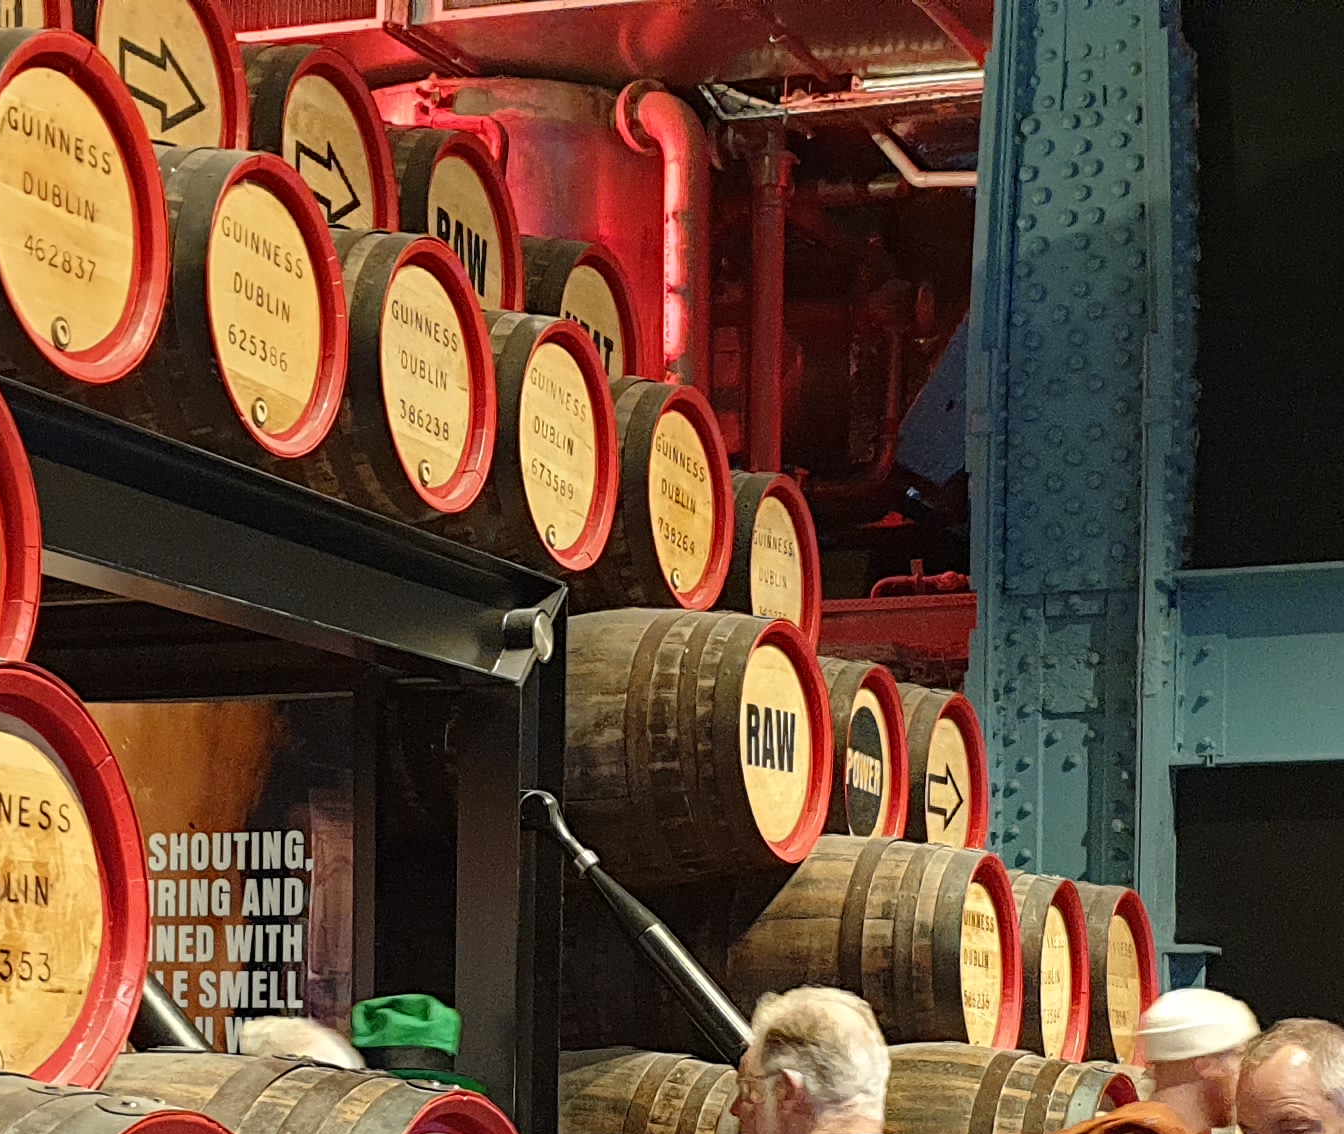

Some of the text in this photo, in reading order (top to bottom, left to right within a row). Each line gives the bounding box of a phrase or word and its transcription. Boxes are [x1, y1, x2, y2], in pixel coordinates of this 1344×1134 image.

[7, 105, 113, 175] GUINNESS
[22, 171, 96, 223] DUBLIN
[24, 234, 96, 282] 462837
[222, 215, 304, 279] GUINNESS
[233, 271, 290, 323] DUBLIN
[228, 324, 288, 372] 625386
[391, 300, 457, 352] GUINNESS
[400, 349, 447, 391] DUBLIN
[530, 367, 587, 423] GUINNESS
[399, 399, 449, 441] 386238
[533, 415, 574, 456] DUBLIN
[531, 457, 574, 500] 673589
[655, 434, 706, 483] GUINNESS
[661, 477, 696, 516] DUBLIN
[758, 566, 787, 589] DUBLIN
[746, 703, 796, 773] RAW
[845, 747, 881, 797] POWER
[148, 830, 314, 872] SHOUTING,
[149, 878, 304, 917] RING AND
[225, 924, 303, 963] WITH
[199, 970, 304, 1008] SMELL
